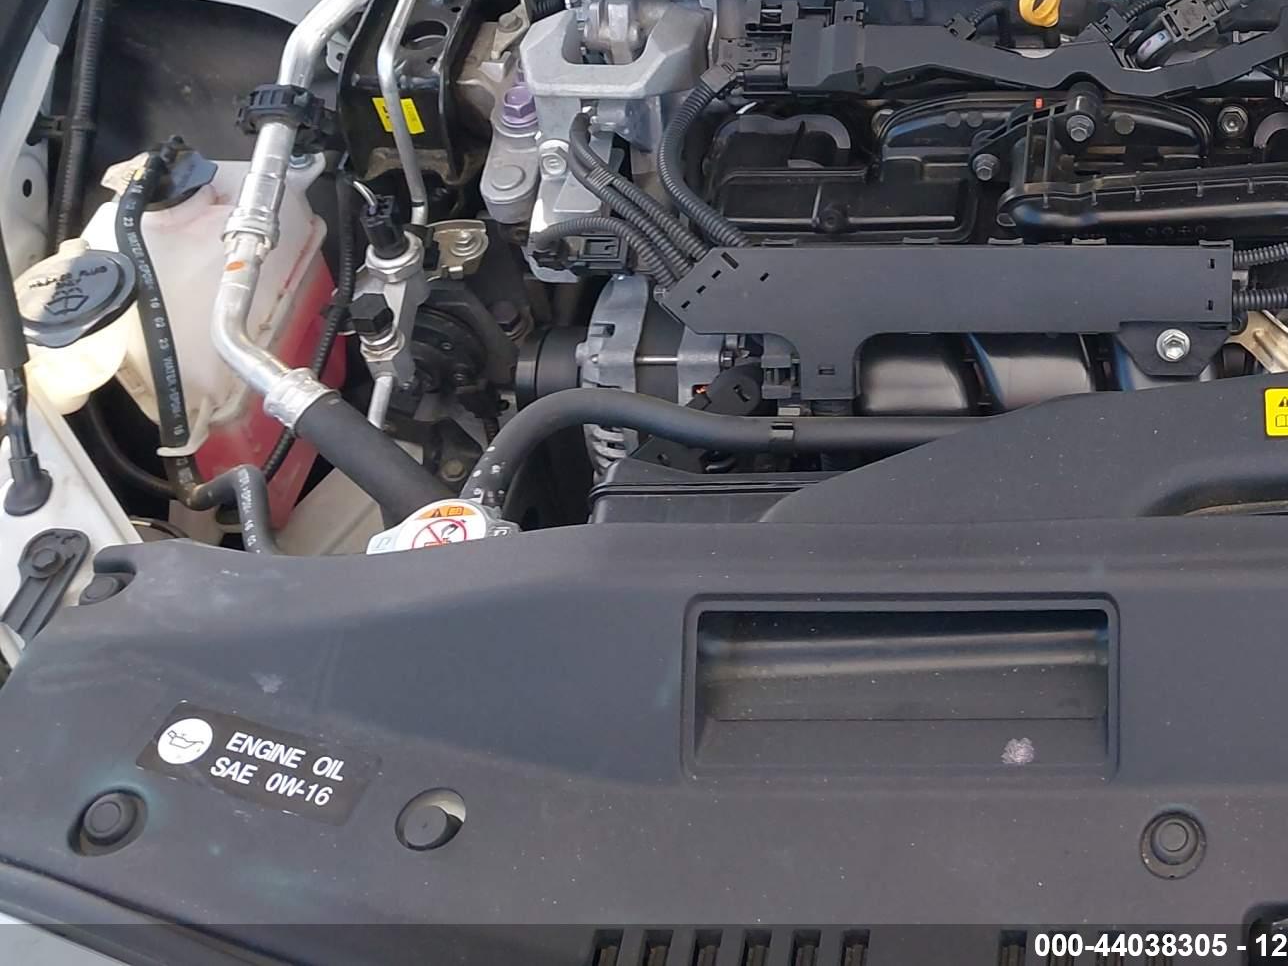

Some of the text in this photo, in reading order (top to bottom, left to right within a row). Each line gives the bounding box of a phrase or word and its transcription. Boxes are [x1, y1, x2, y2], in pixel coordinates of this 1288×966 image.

[210, 757, 333, 806] SAE 0W-16
[225, 731, 344, 782] ENGINE OIL
